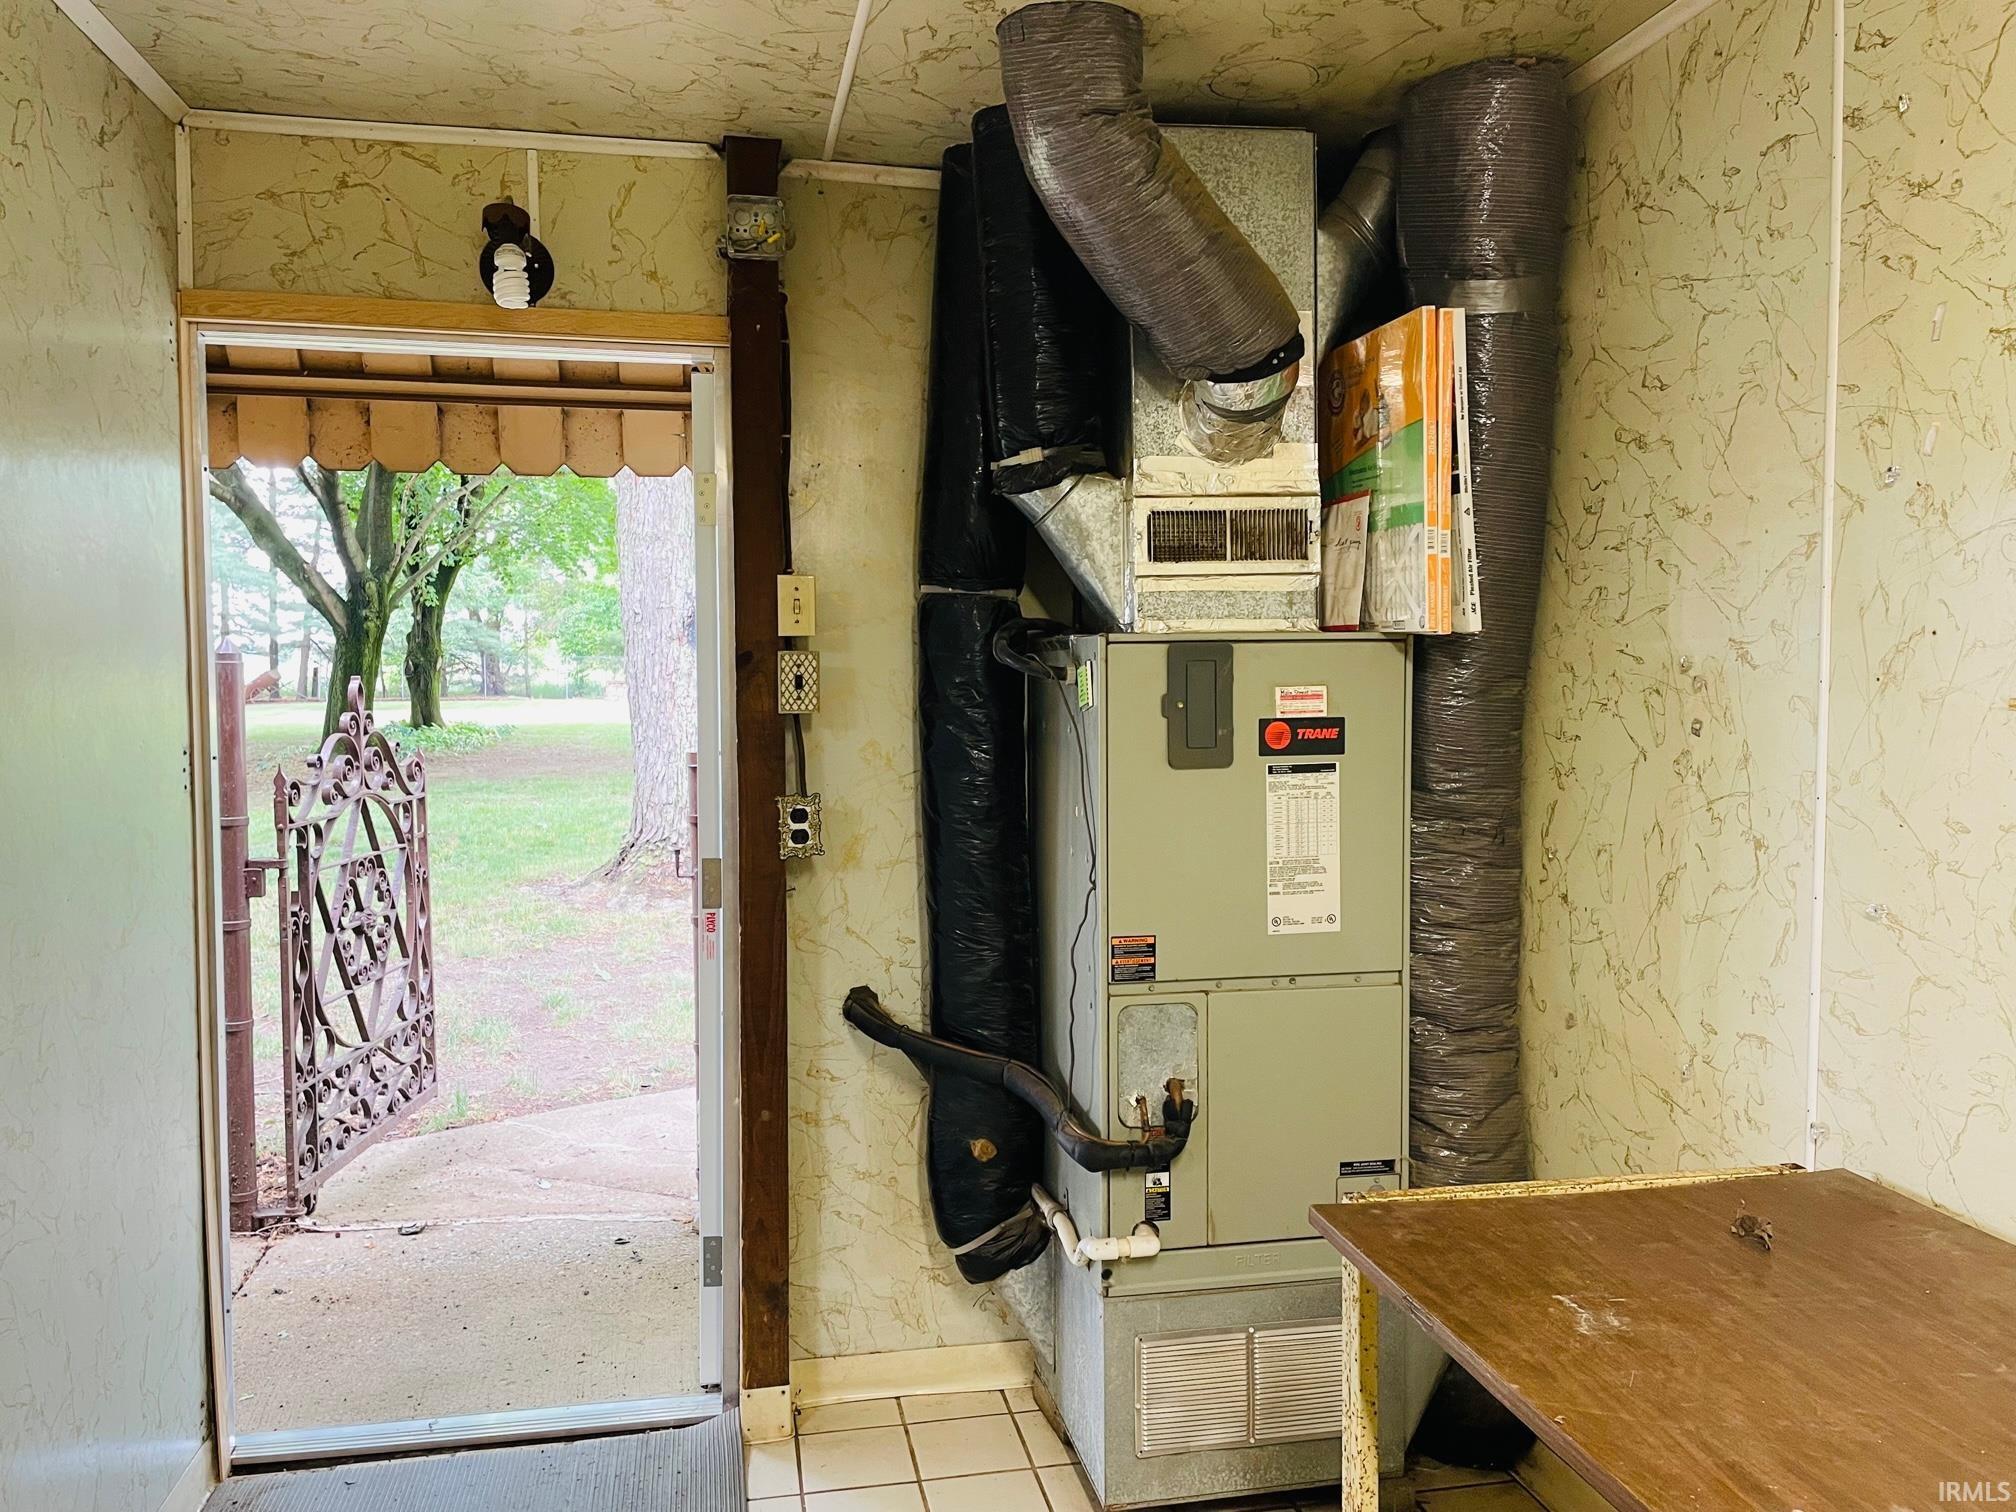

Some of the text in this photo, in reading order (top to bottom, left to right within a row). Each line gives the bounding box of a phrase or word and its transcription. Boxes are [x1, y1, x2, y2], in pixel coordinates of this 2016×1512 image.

[1297, 728, 1339, 740] TRANE
[706, 912, 716, 933] PLYCO
[1233, 1252, 1280, 1266] FILTER
